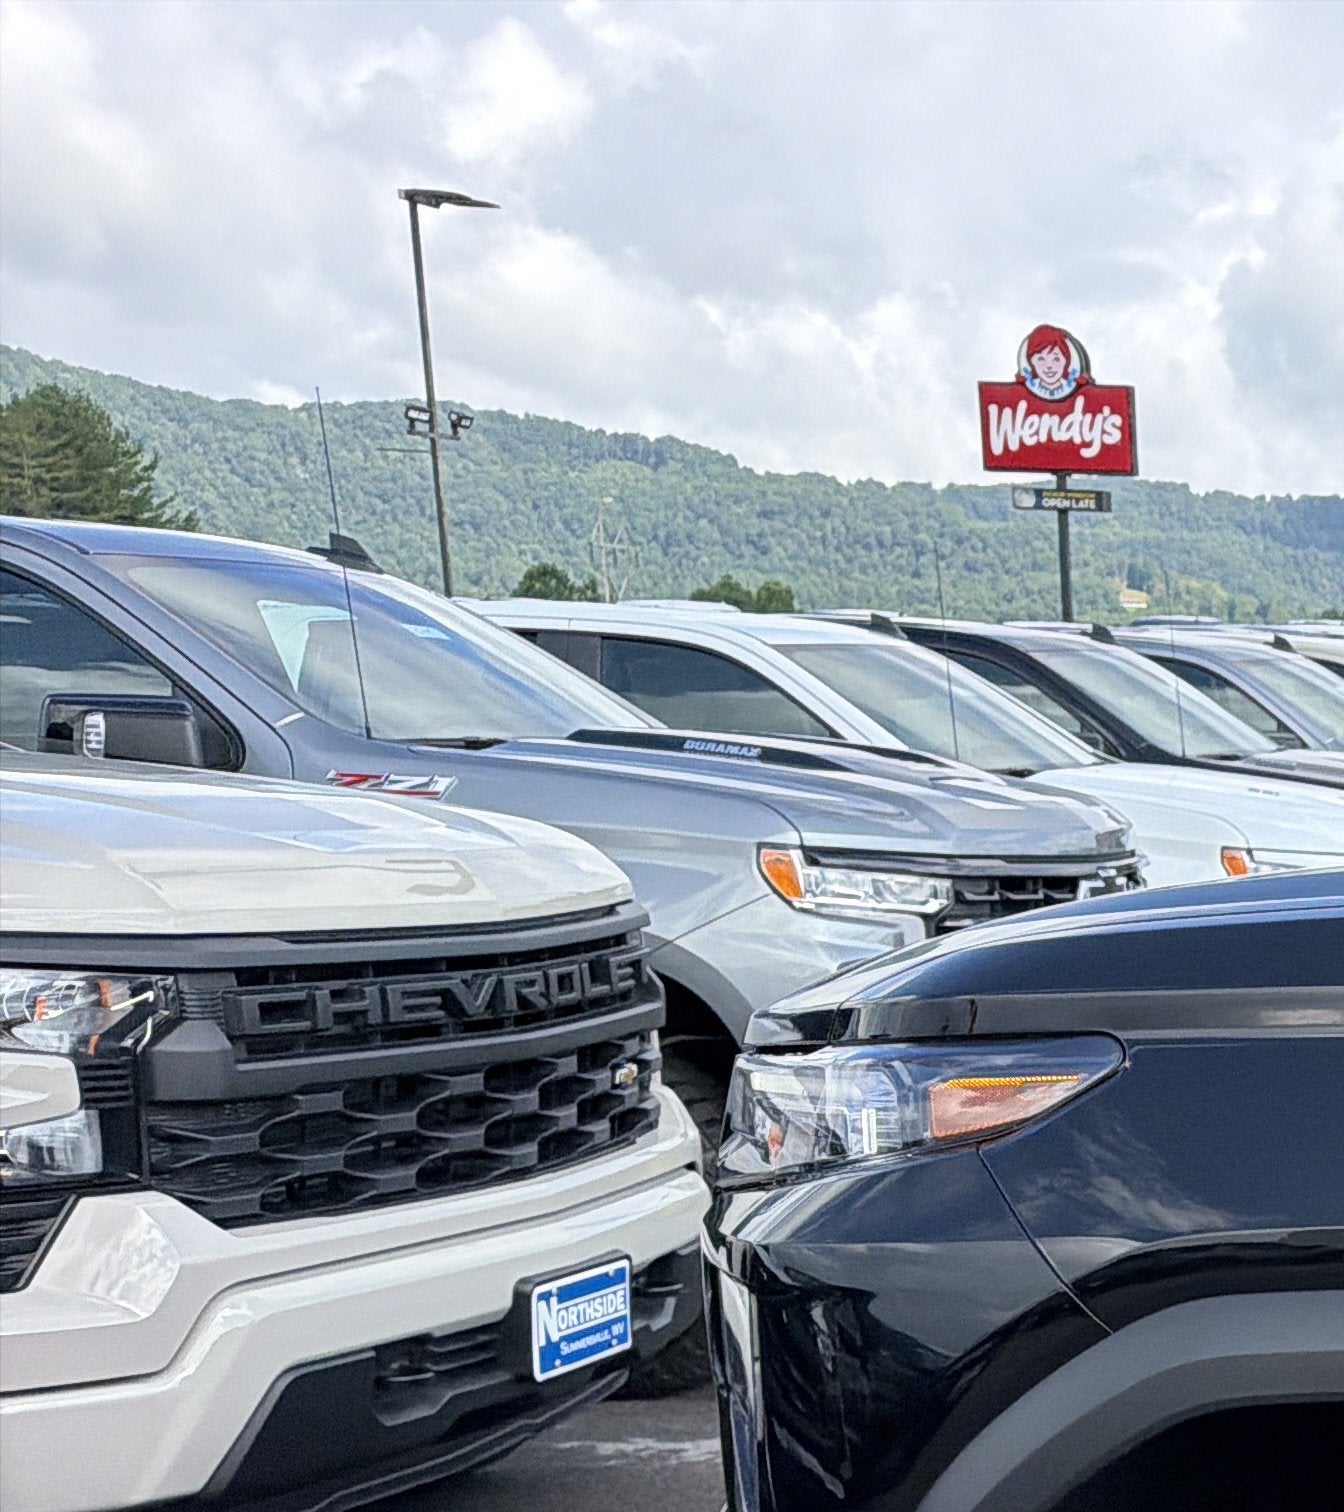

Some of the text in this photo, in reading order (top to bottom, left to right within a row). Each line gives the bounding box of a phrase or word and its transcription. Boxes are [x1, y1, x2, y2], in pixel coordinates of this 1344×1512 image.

[987, 395, 1123, 459] Wendy's
[683, 739, 762, 758] DURAMAX
[325, 768, 458, 800] Z71
[537, 1290, 626, 1347] NORTHSIDE
